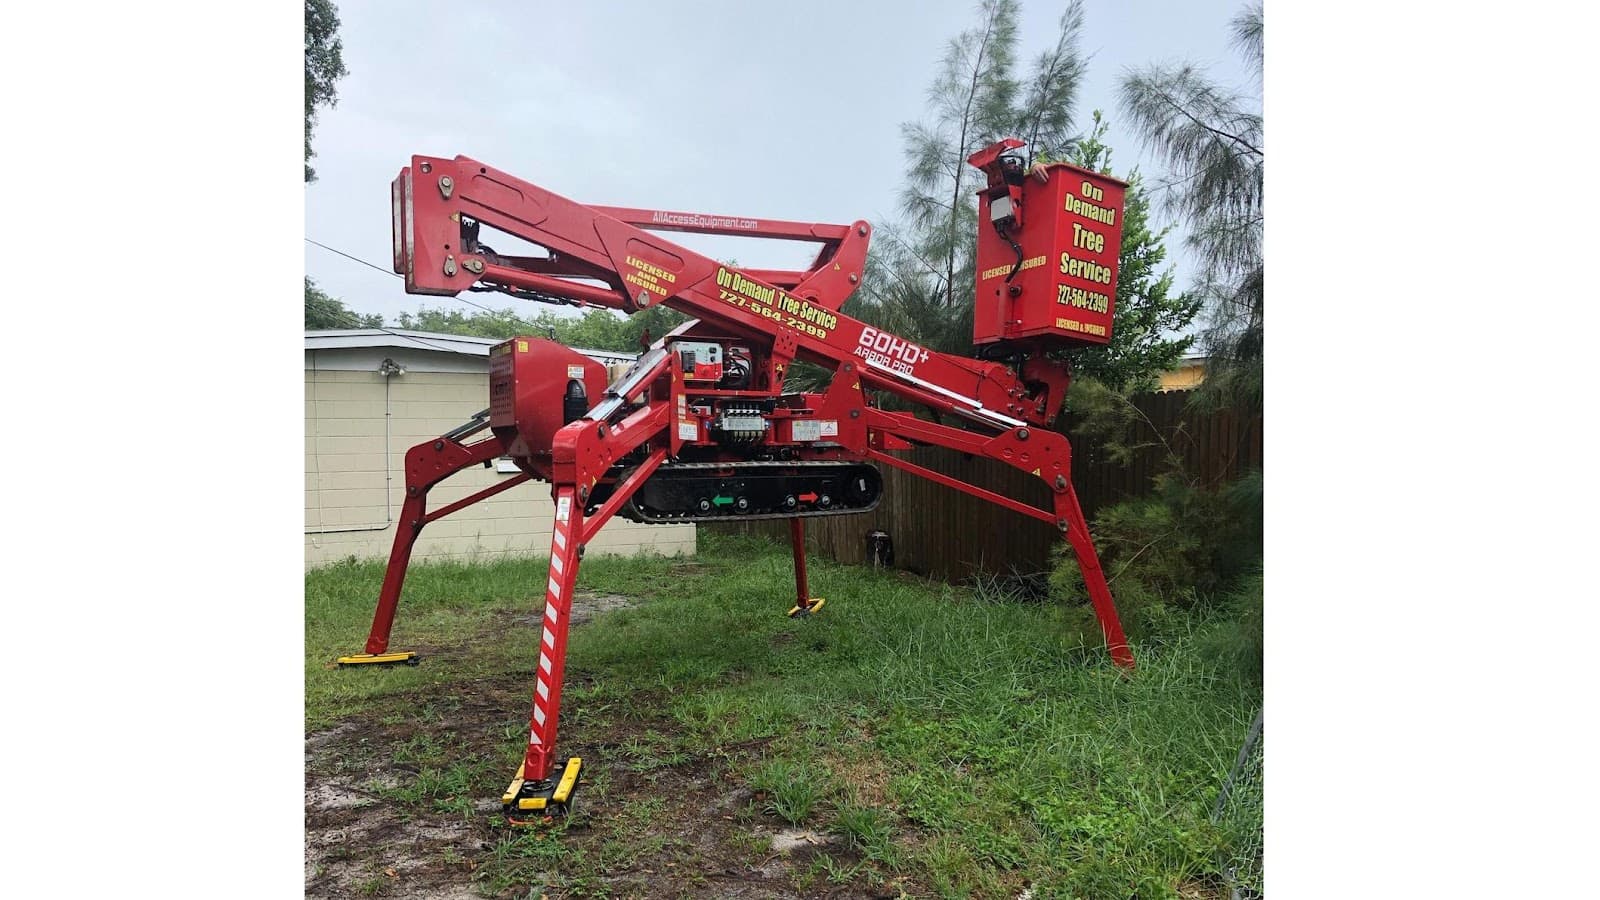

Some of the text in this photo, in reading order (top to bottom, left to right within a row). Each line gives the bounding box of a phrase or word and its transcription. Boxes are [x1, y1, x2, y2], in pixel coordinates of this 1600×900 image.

[1081, 181, 1103, 202] On
[652, 211, 758, 229] AllAccessEquipment.com
[1064, 193, 1115, 226] Demand
[1073, 224, 1105, 254] Tree
[625, 256, 676, 284] LICENSED
[636, 271, 658, 284] AND
[982, 264, 1011, 281] LICENSED
[1060, 252, 1111, 285] Service
[626, 274, 668, 297] INSURED
[716, 267, 837, 330] On Demand Tree Service
[1057, 284, 1109, 315] 727-564-2399
[719, 288, 827, 339] 727-564-2399
[1055, 317, 1080, 332] LICENSED
[859, 326, 929, 364] 60HD+
[854, 345, 914, 376] ARBOR PRO
